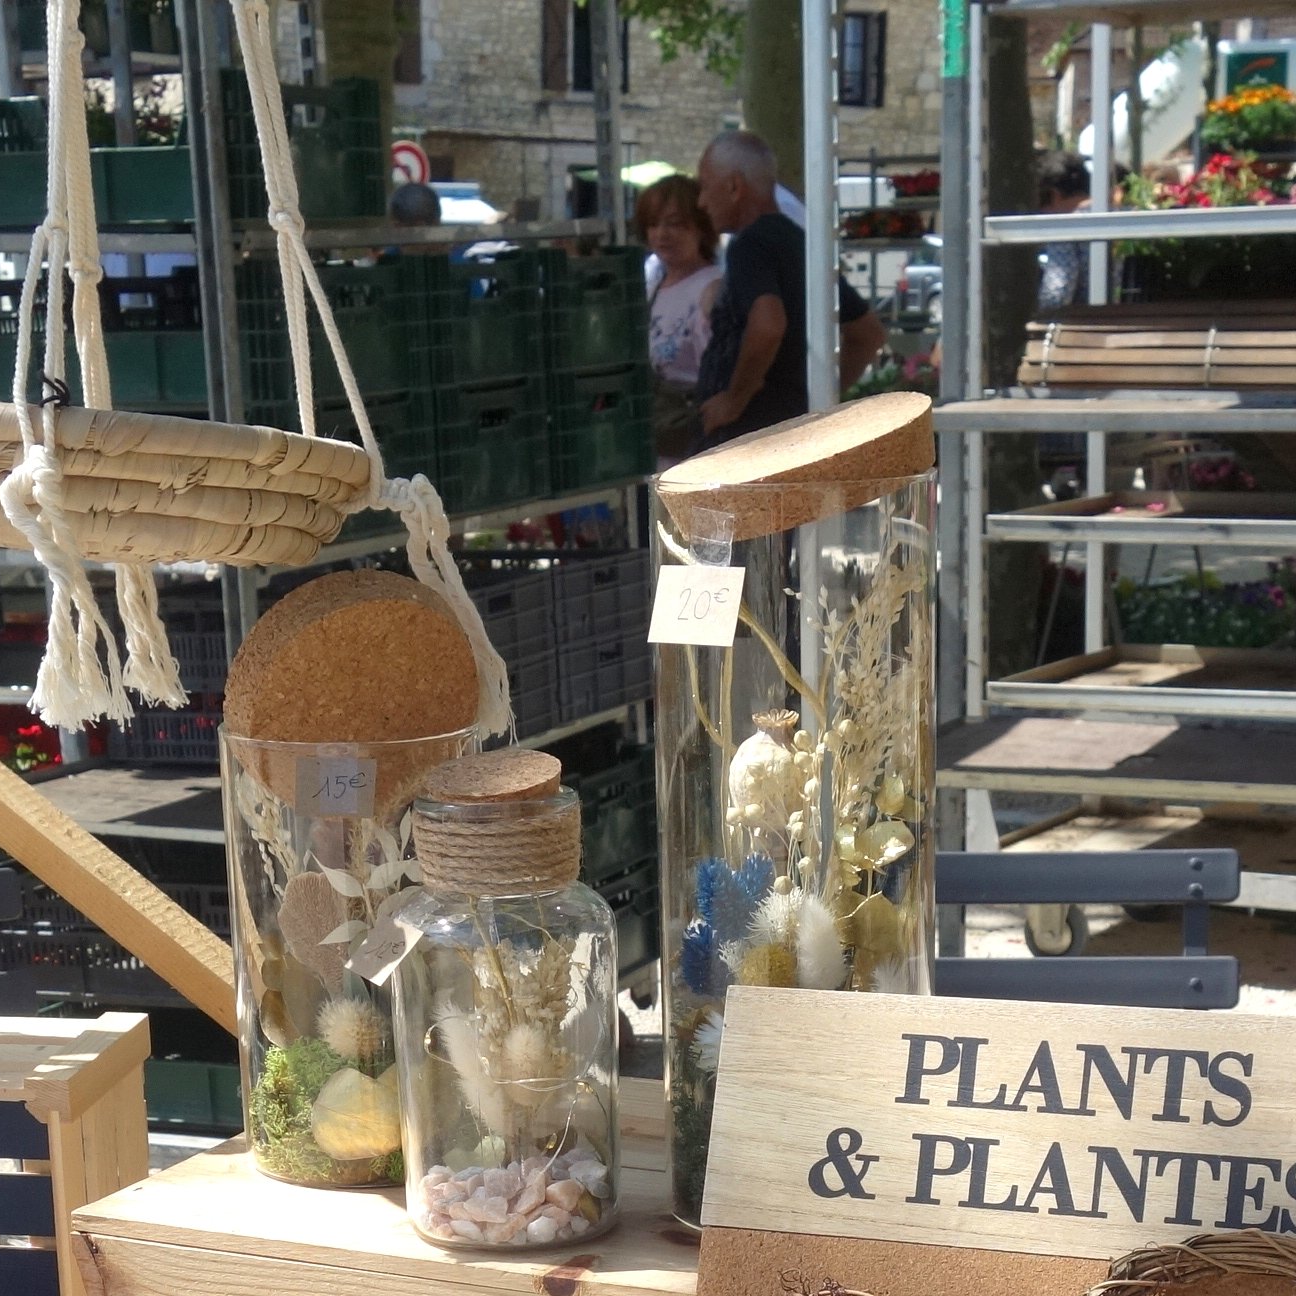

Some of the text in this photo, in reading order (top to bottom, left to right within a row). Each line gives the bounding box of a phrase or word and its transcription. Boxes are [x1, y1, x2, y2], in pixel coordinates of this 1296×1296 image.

[677, 587, 730, 621] 20€
[312, 772, 368, 799] 15€
[894, 1032, 1254, 1127] PLANTS
[807, 1127, 880, 1200] &
